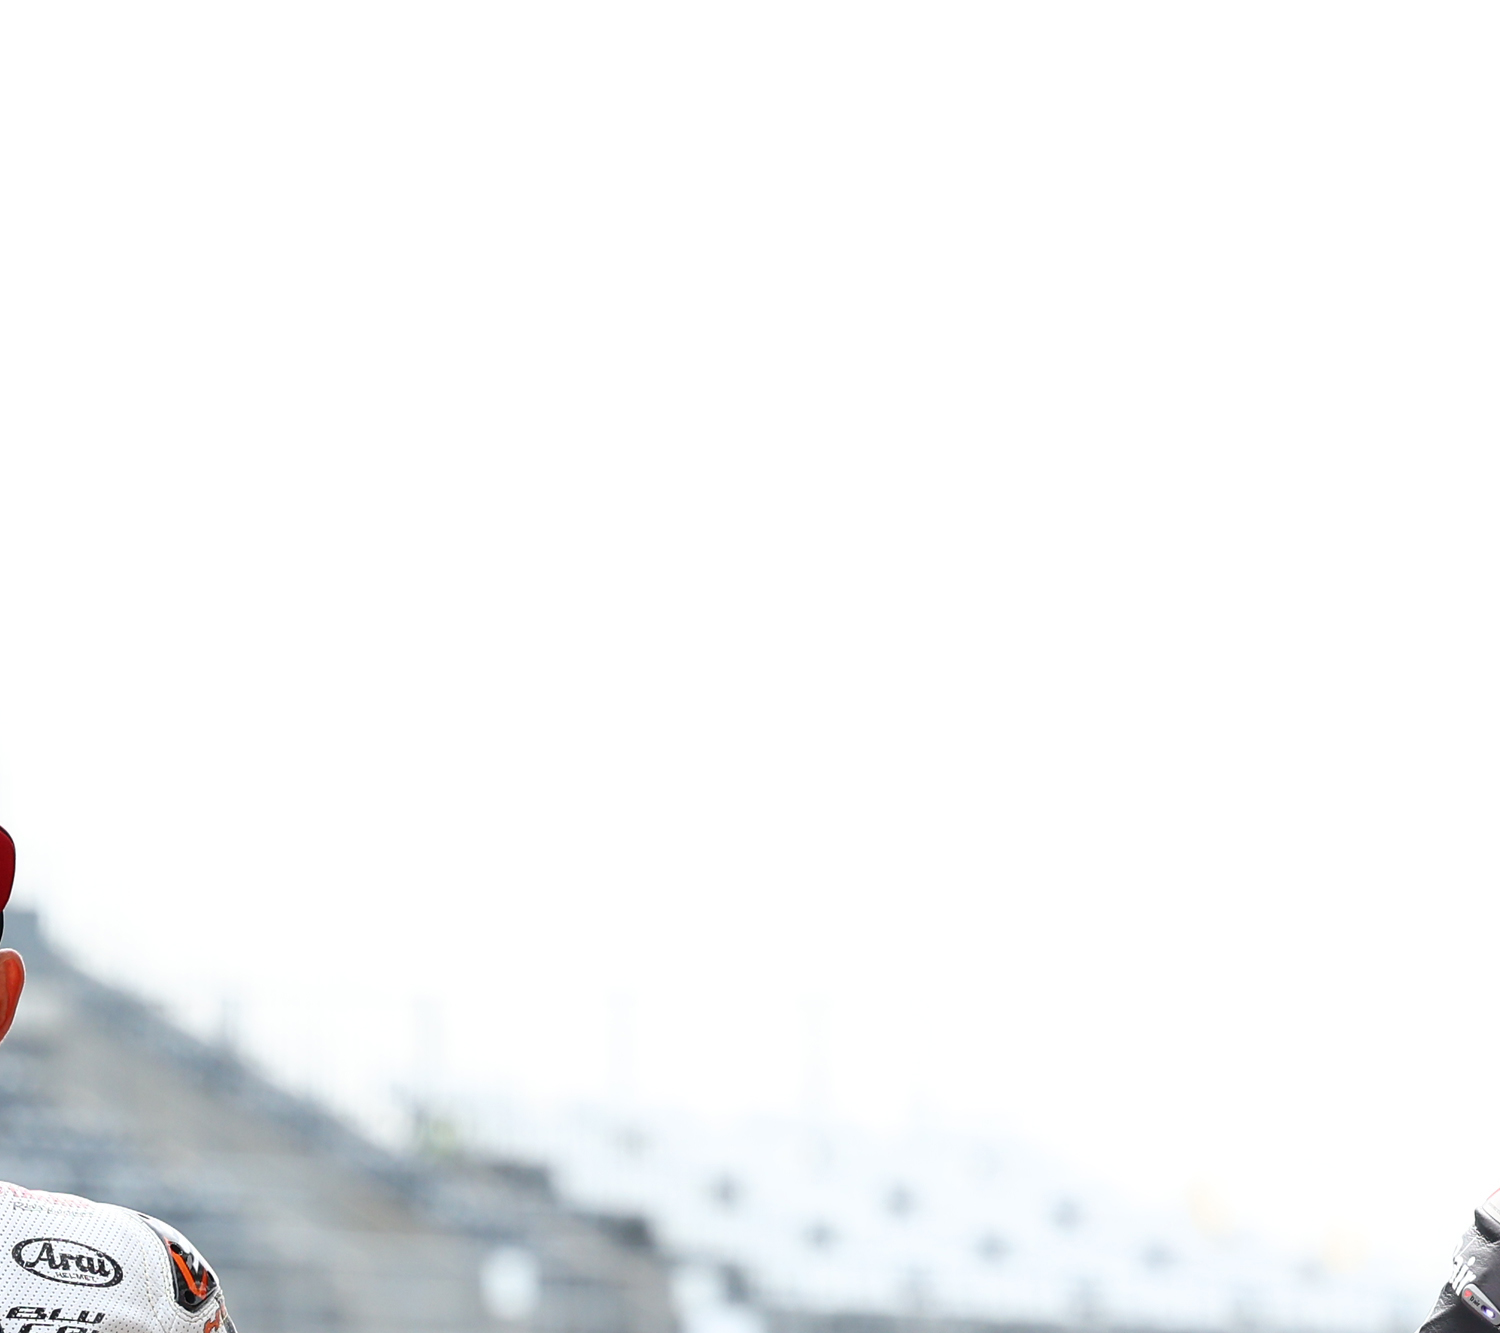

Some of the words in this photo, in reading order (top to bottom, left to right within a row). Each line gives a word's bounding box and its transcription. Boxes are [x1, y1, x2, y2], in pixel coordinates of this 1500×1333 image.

[25, 1241, 112, 1278] Arai
[54, 1271, 100, 1283] HELMET
[6, 1306, 106, 1325] BLU
